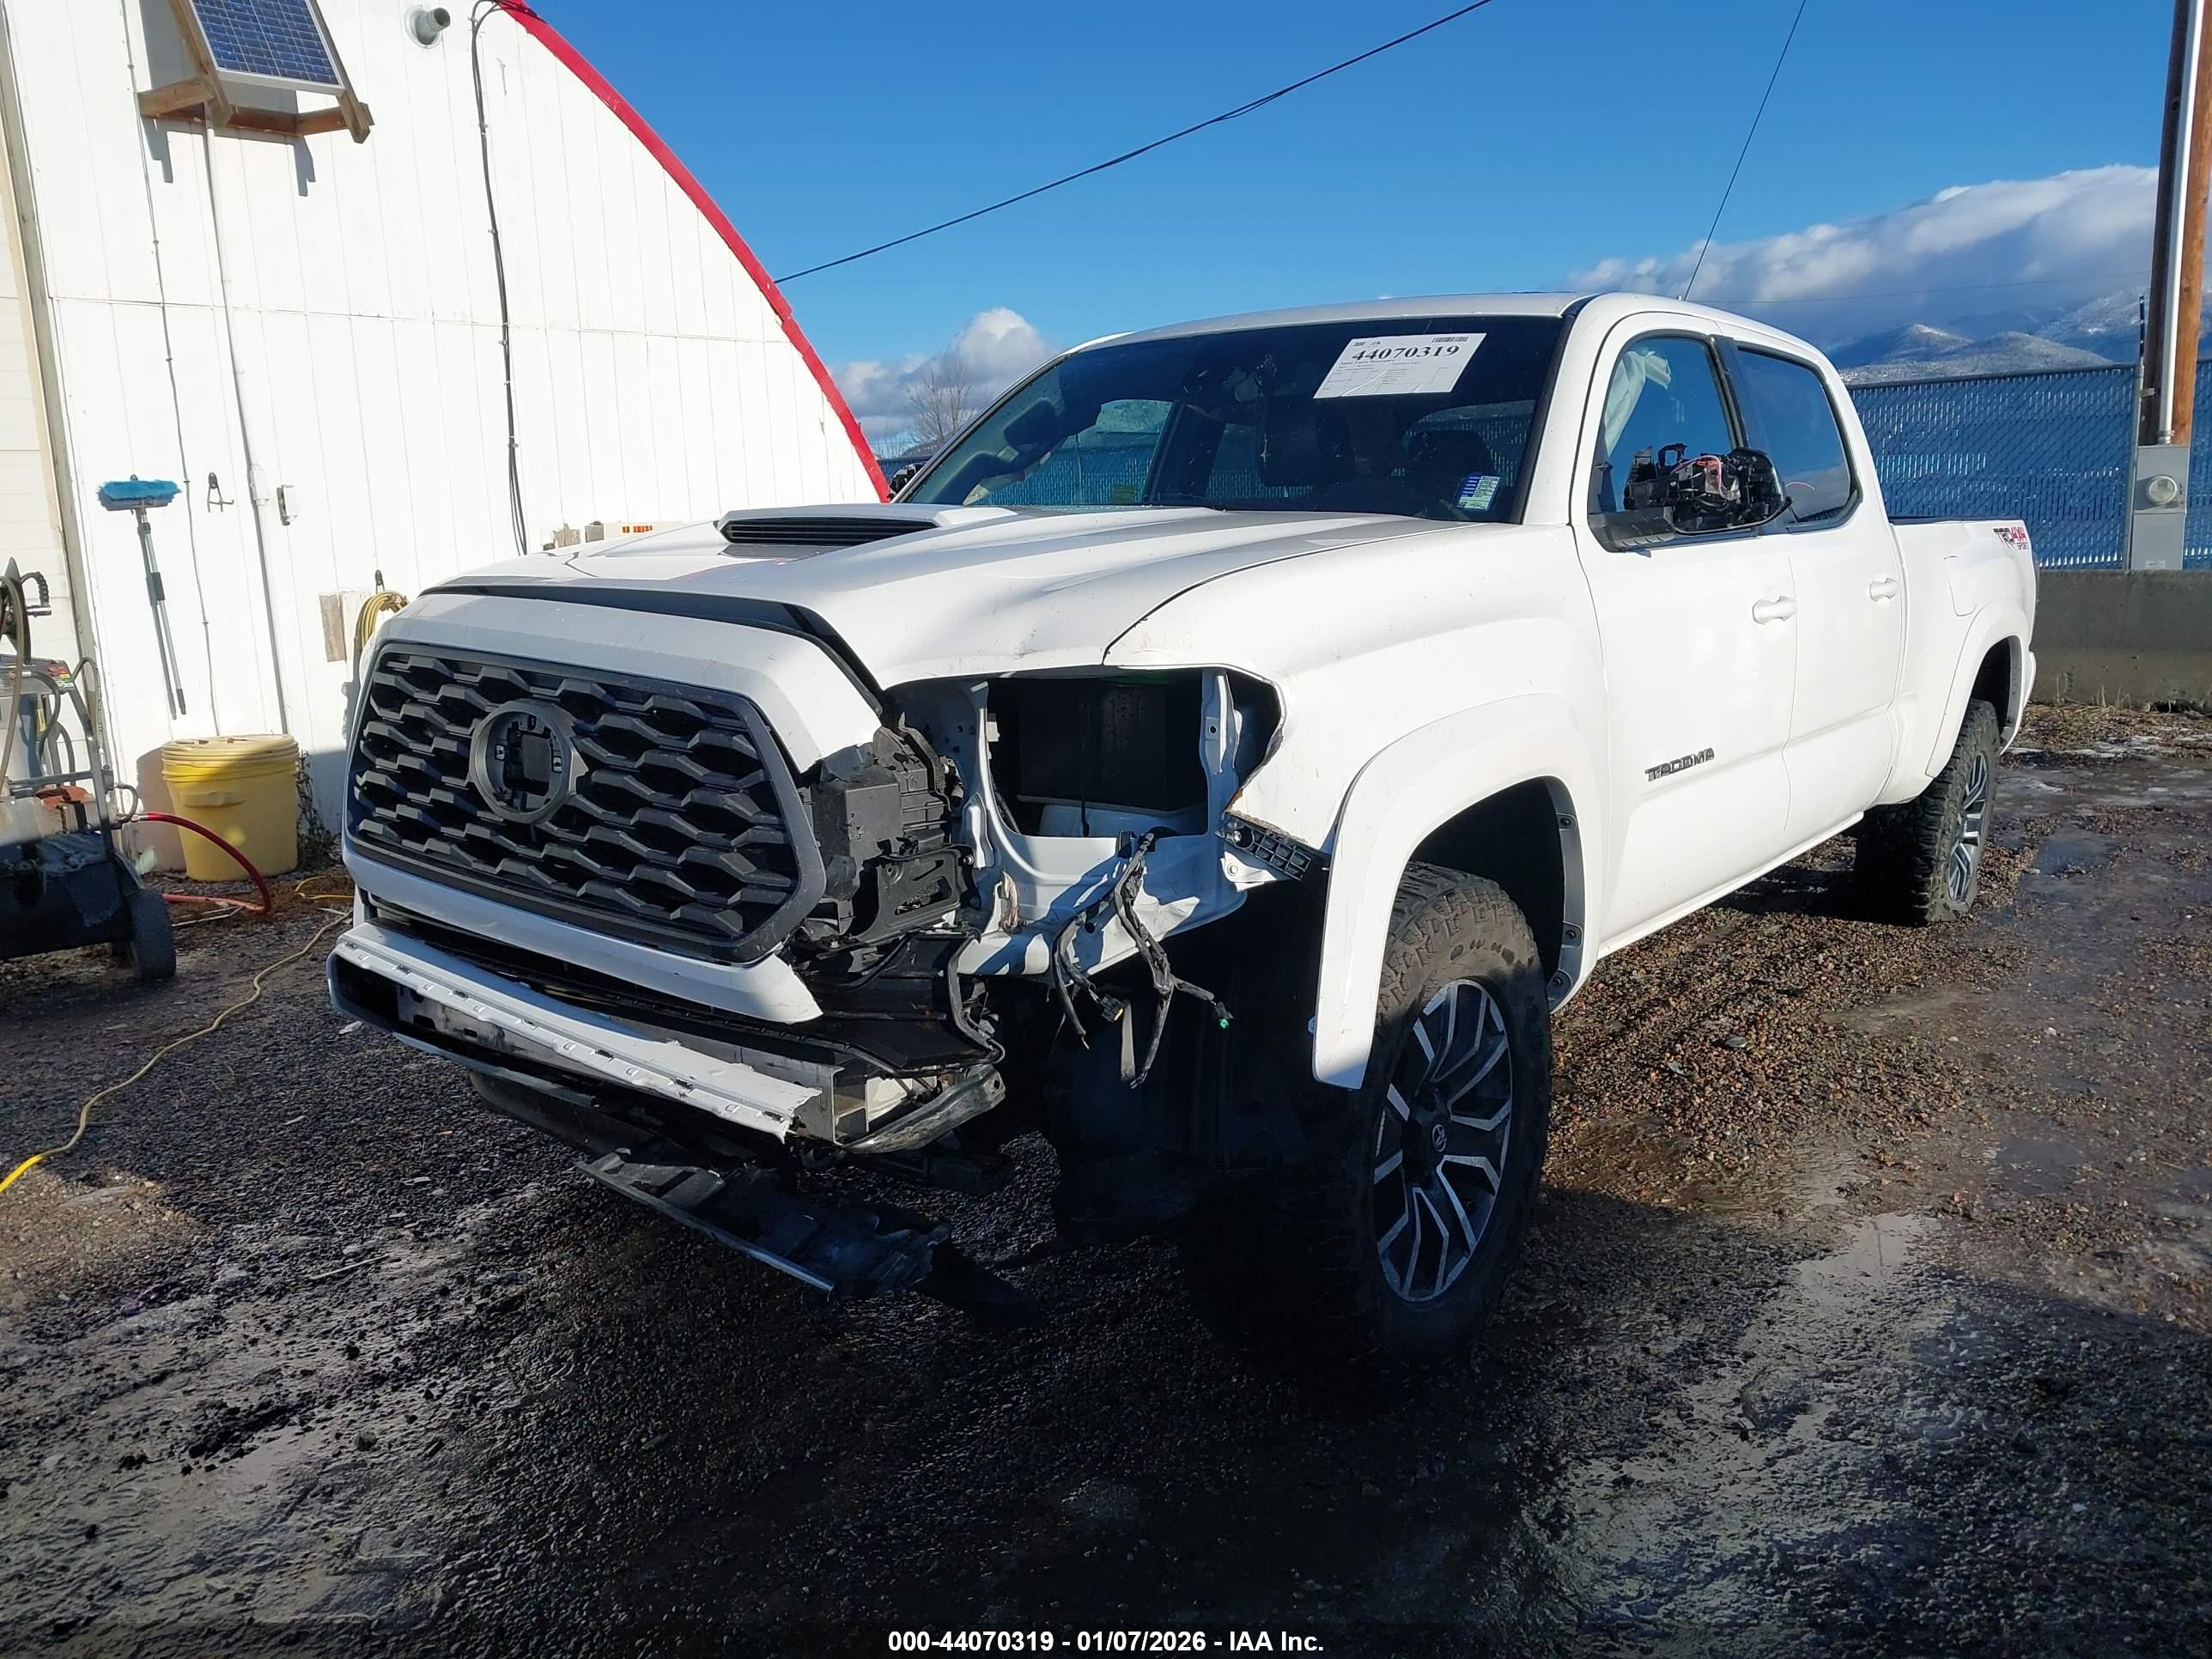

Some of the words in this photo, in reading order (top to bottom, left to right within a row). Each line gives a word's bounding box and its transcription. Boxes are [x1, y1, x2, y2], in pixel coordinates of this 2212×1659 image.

[1352, 345, 1460, 361] 44070319
[1993, 527, 2015, 547] TRD
[1644, 747, 1716, 782] TACOMA
